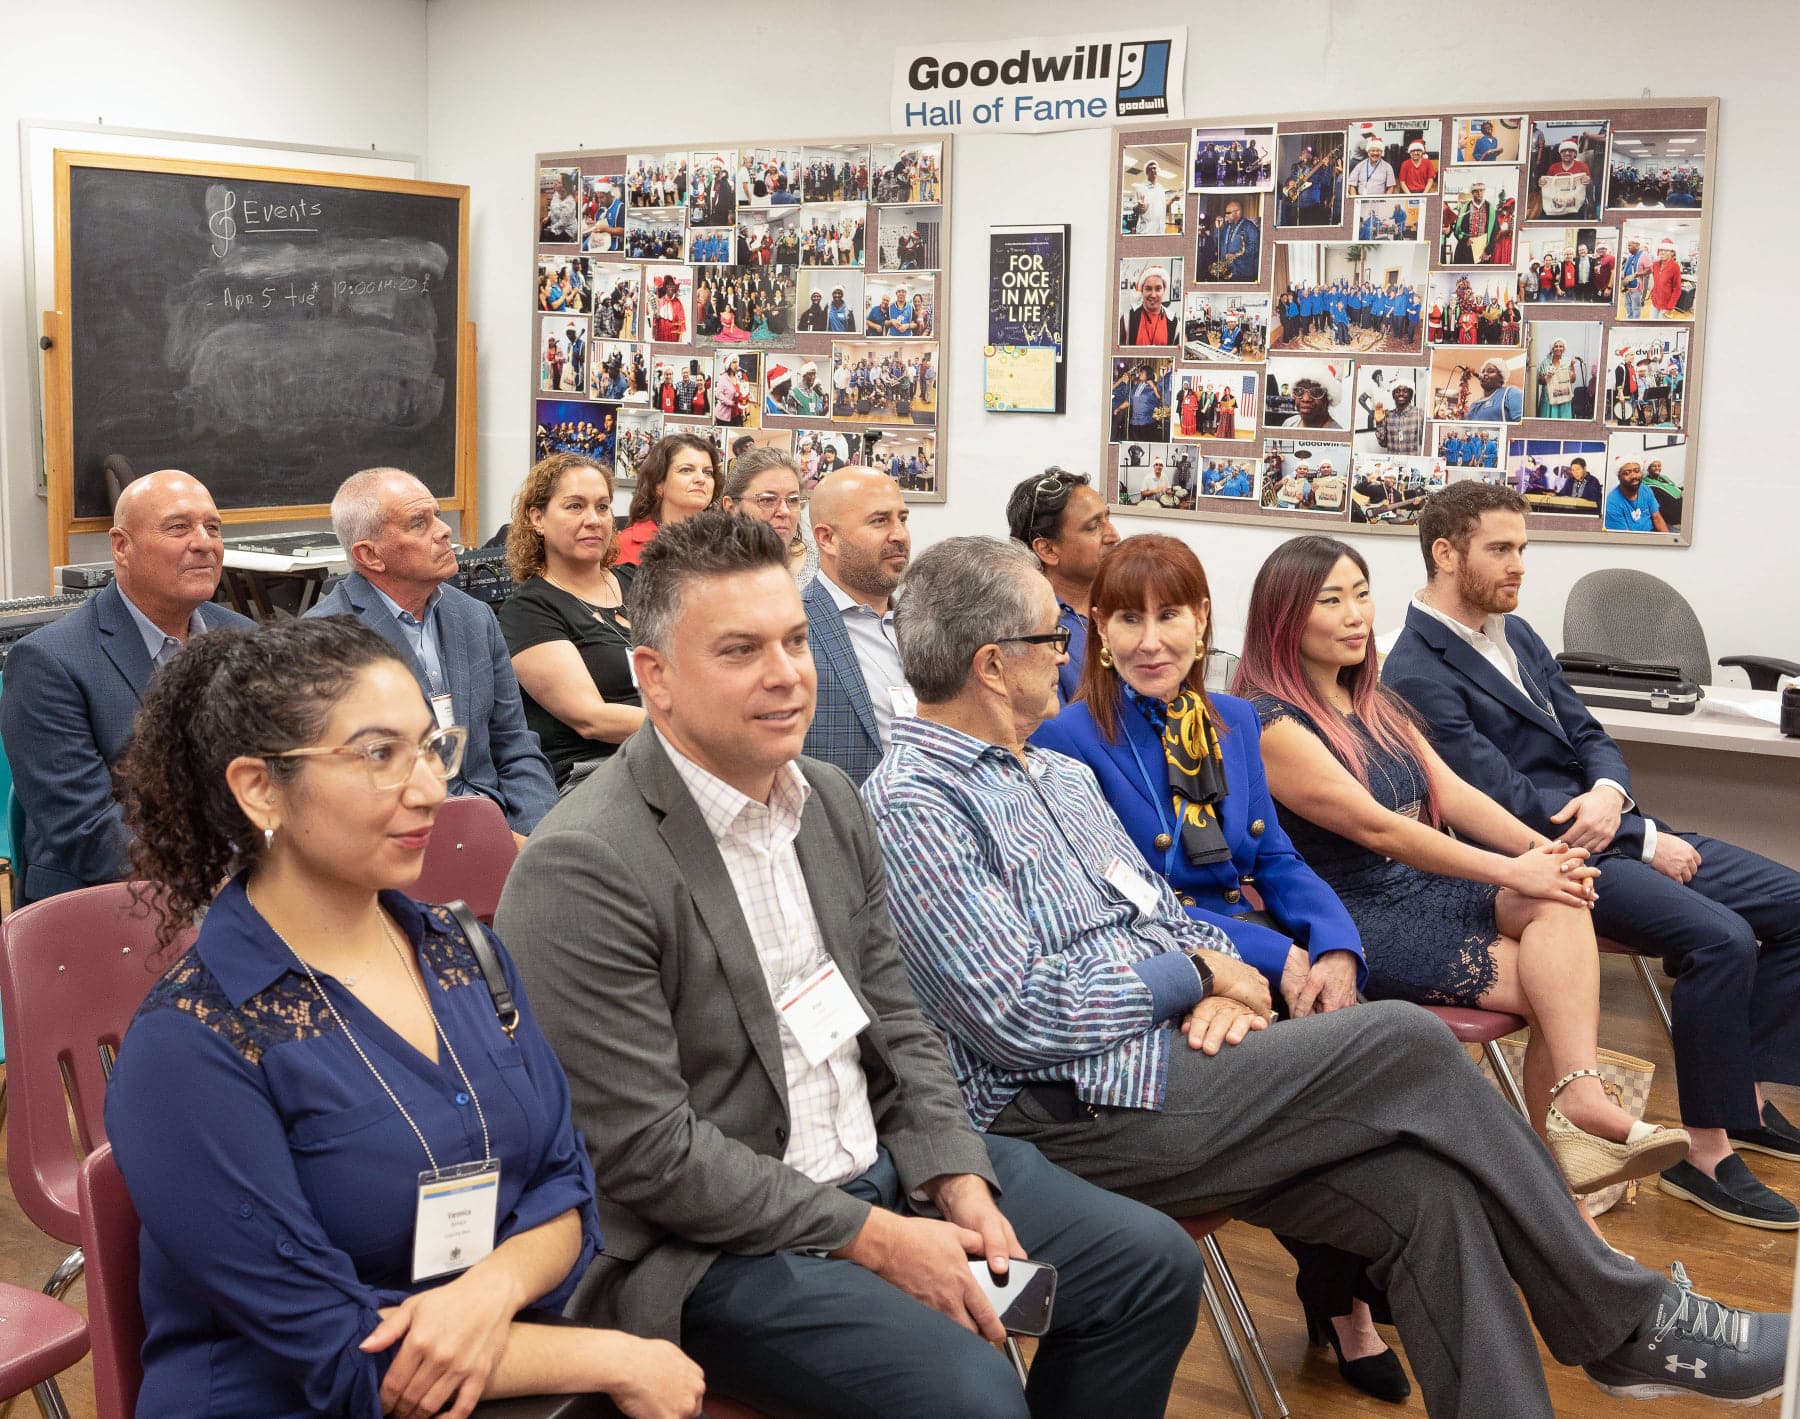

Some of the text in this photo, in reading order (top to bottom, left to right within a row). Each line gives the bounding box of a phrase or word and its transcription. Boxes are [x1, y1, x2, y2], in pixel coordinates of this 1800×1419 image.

[908, 43, 1112, 91] Goodwill
[905, 95, 1107, 127] Hall of Fame
[1118, 97, 1165, 115] goodwill
[243, 198, 322, 224] Events
[1009, 254, 1044, 271] FOR
[1001, 272, 1050, 288] ONCE
[262, 288, 276, 308] 5
[1002, 289, 1050, 305] IN MY
[1009, 306, 1041, 322] LIFE
